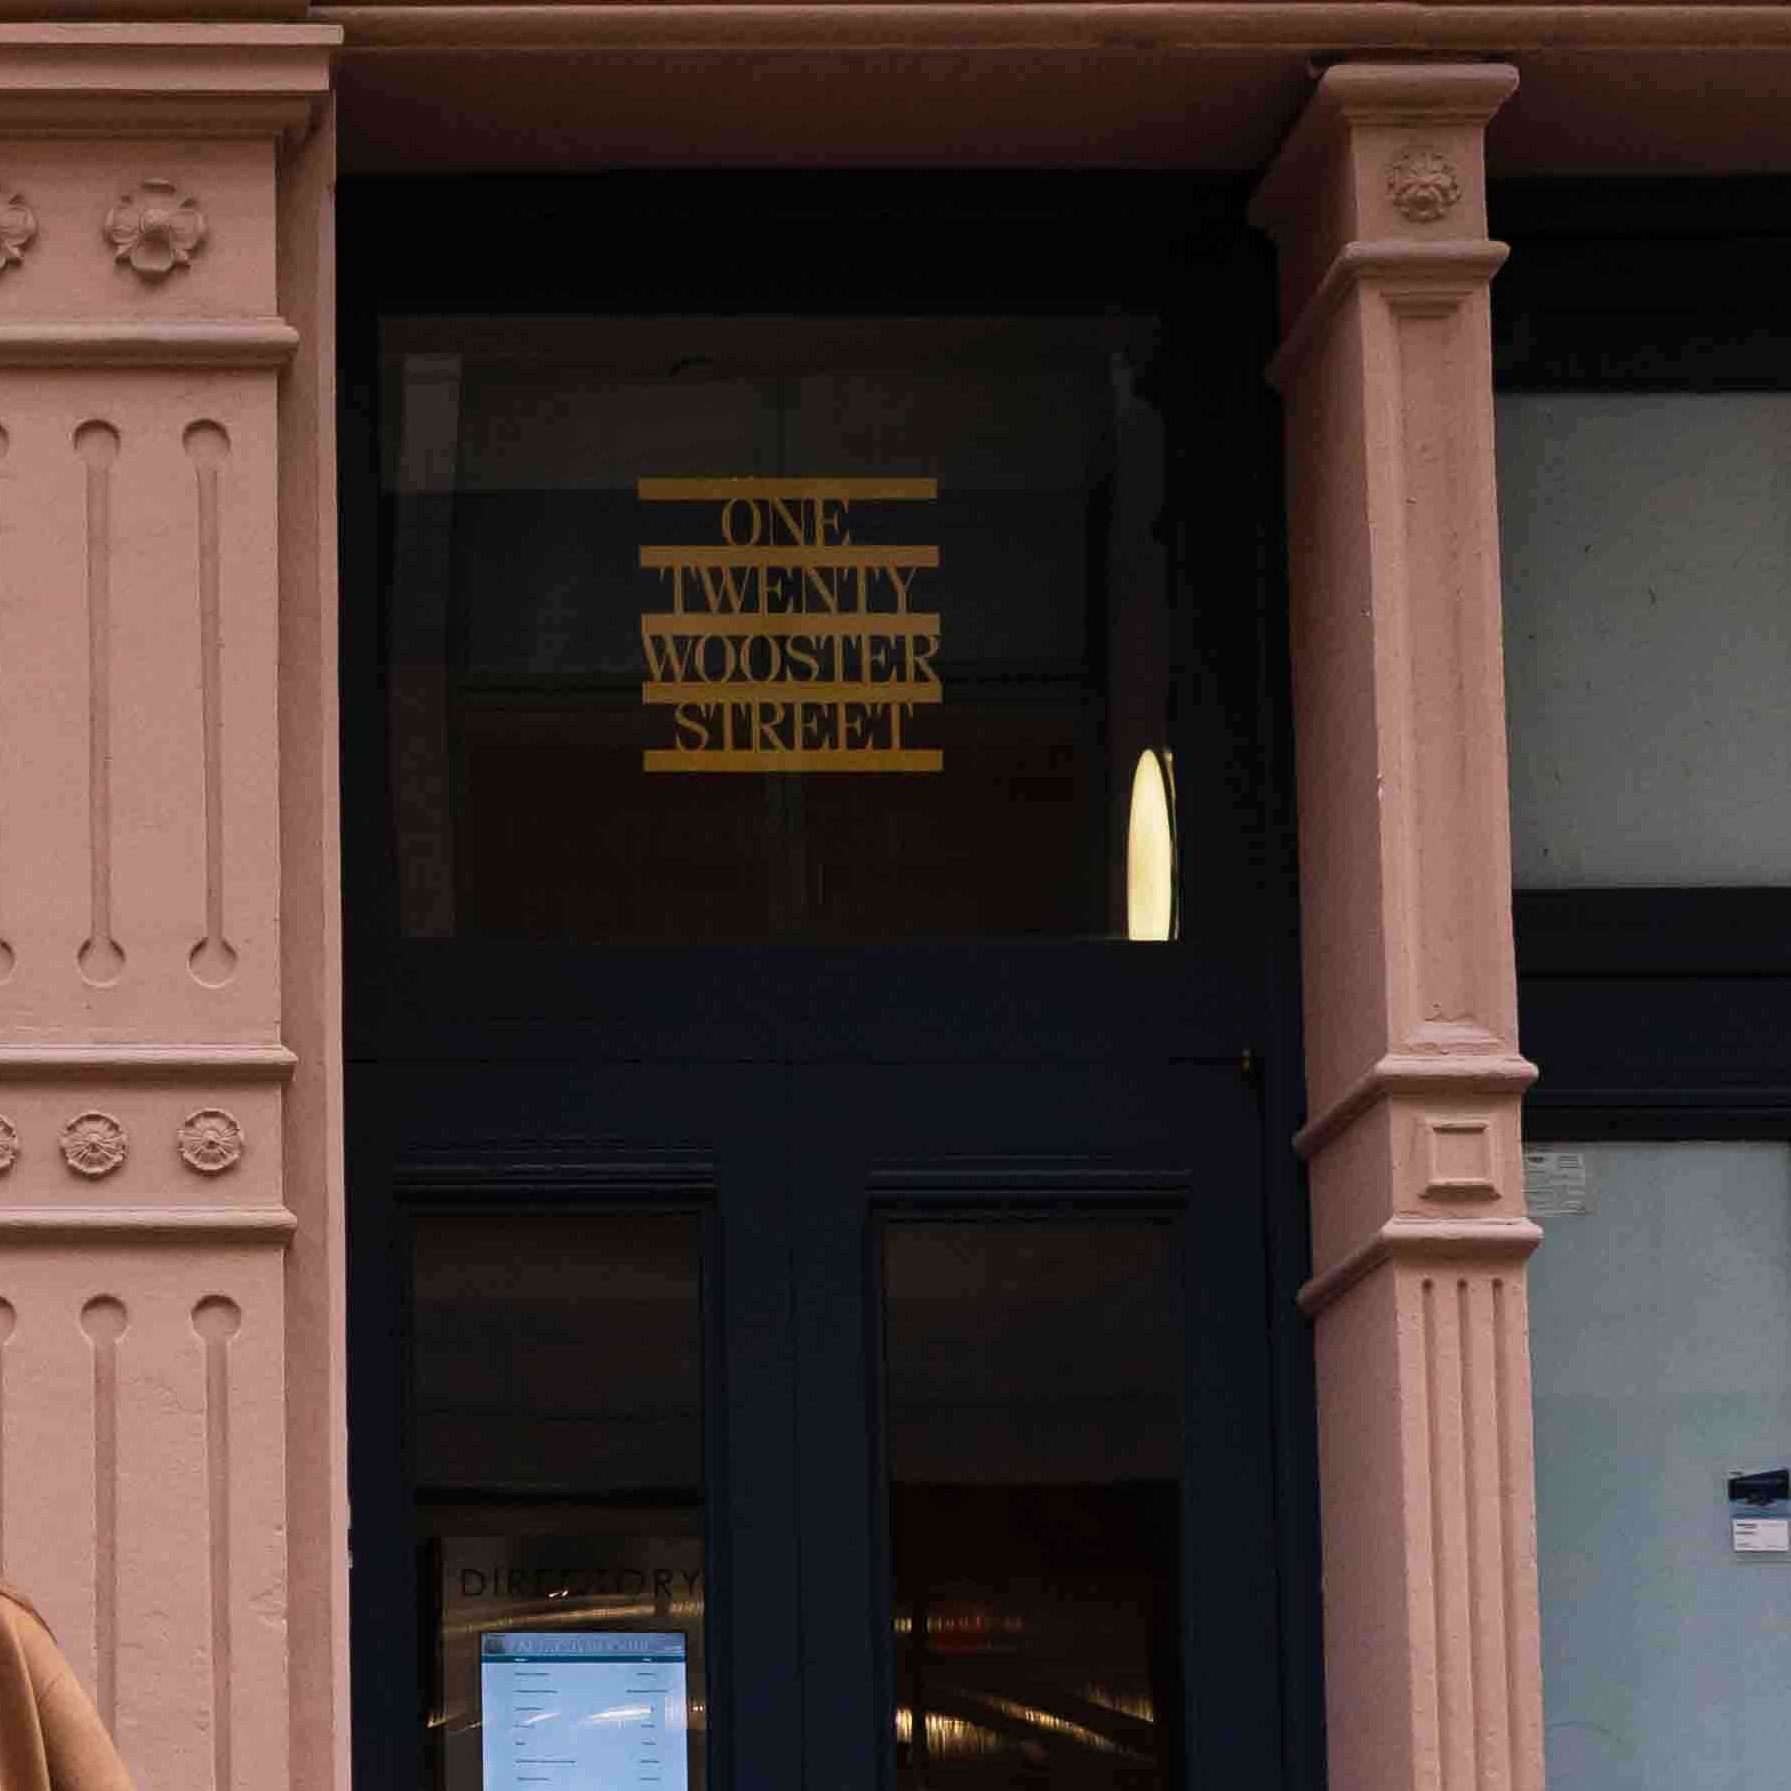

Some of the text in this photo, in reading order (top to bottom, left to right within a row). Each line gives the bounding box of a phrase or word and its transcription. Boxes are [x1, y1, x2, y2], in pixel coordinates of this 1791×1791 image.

[721, 497, 850, 547] ONE
[658, 565, 918, 616] TWENTY
[641, 633, 941, 683] WOOSTER
[674, 702, 913, 751] STREET
